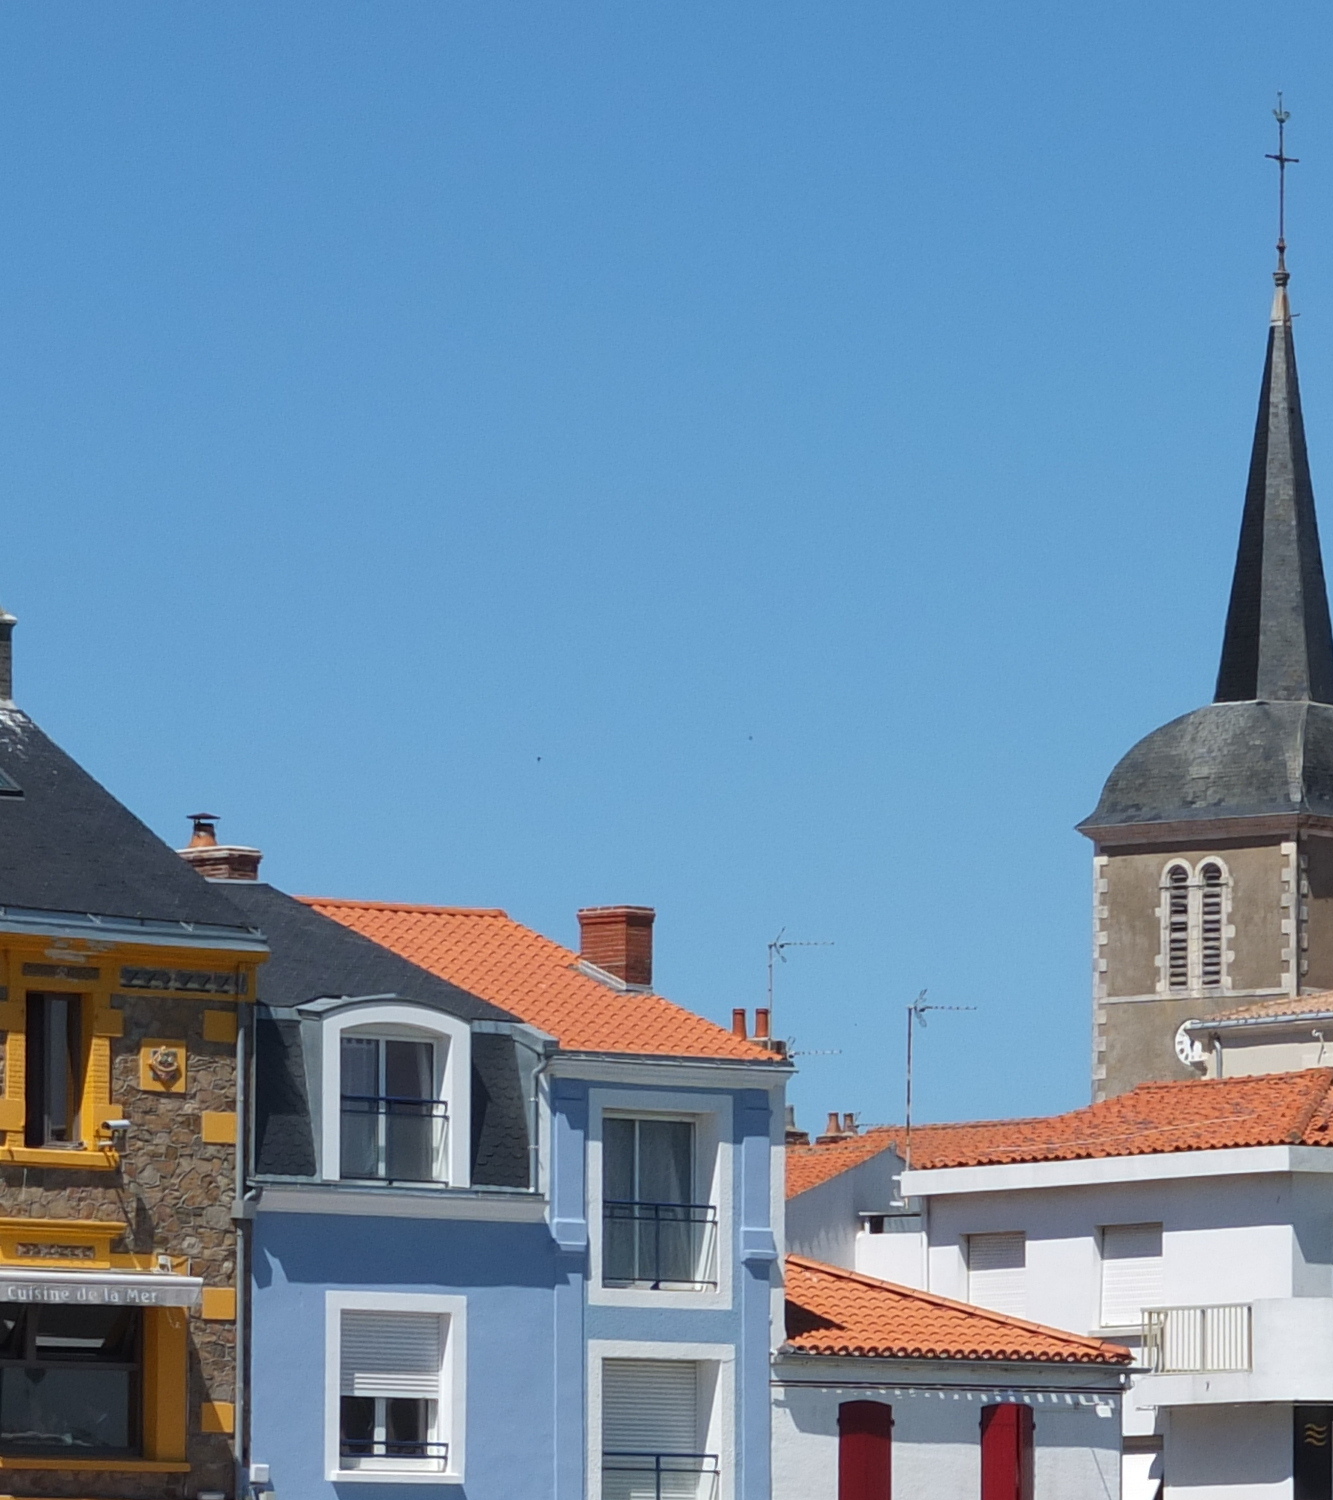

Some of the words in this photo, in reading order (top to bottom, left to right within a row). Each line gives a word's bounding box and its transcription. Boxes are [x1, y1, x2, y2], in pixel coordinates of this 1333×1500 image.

[7, 1286, 70, 1301] Cuisine
[76, 1287, 98, 1301] de
[104, 1287, 119, 1303] la
[127, 1288, 158, 1303] Mer
